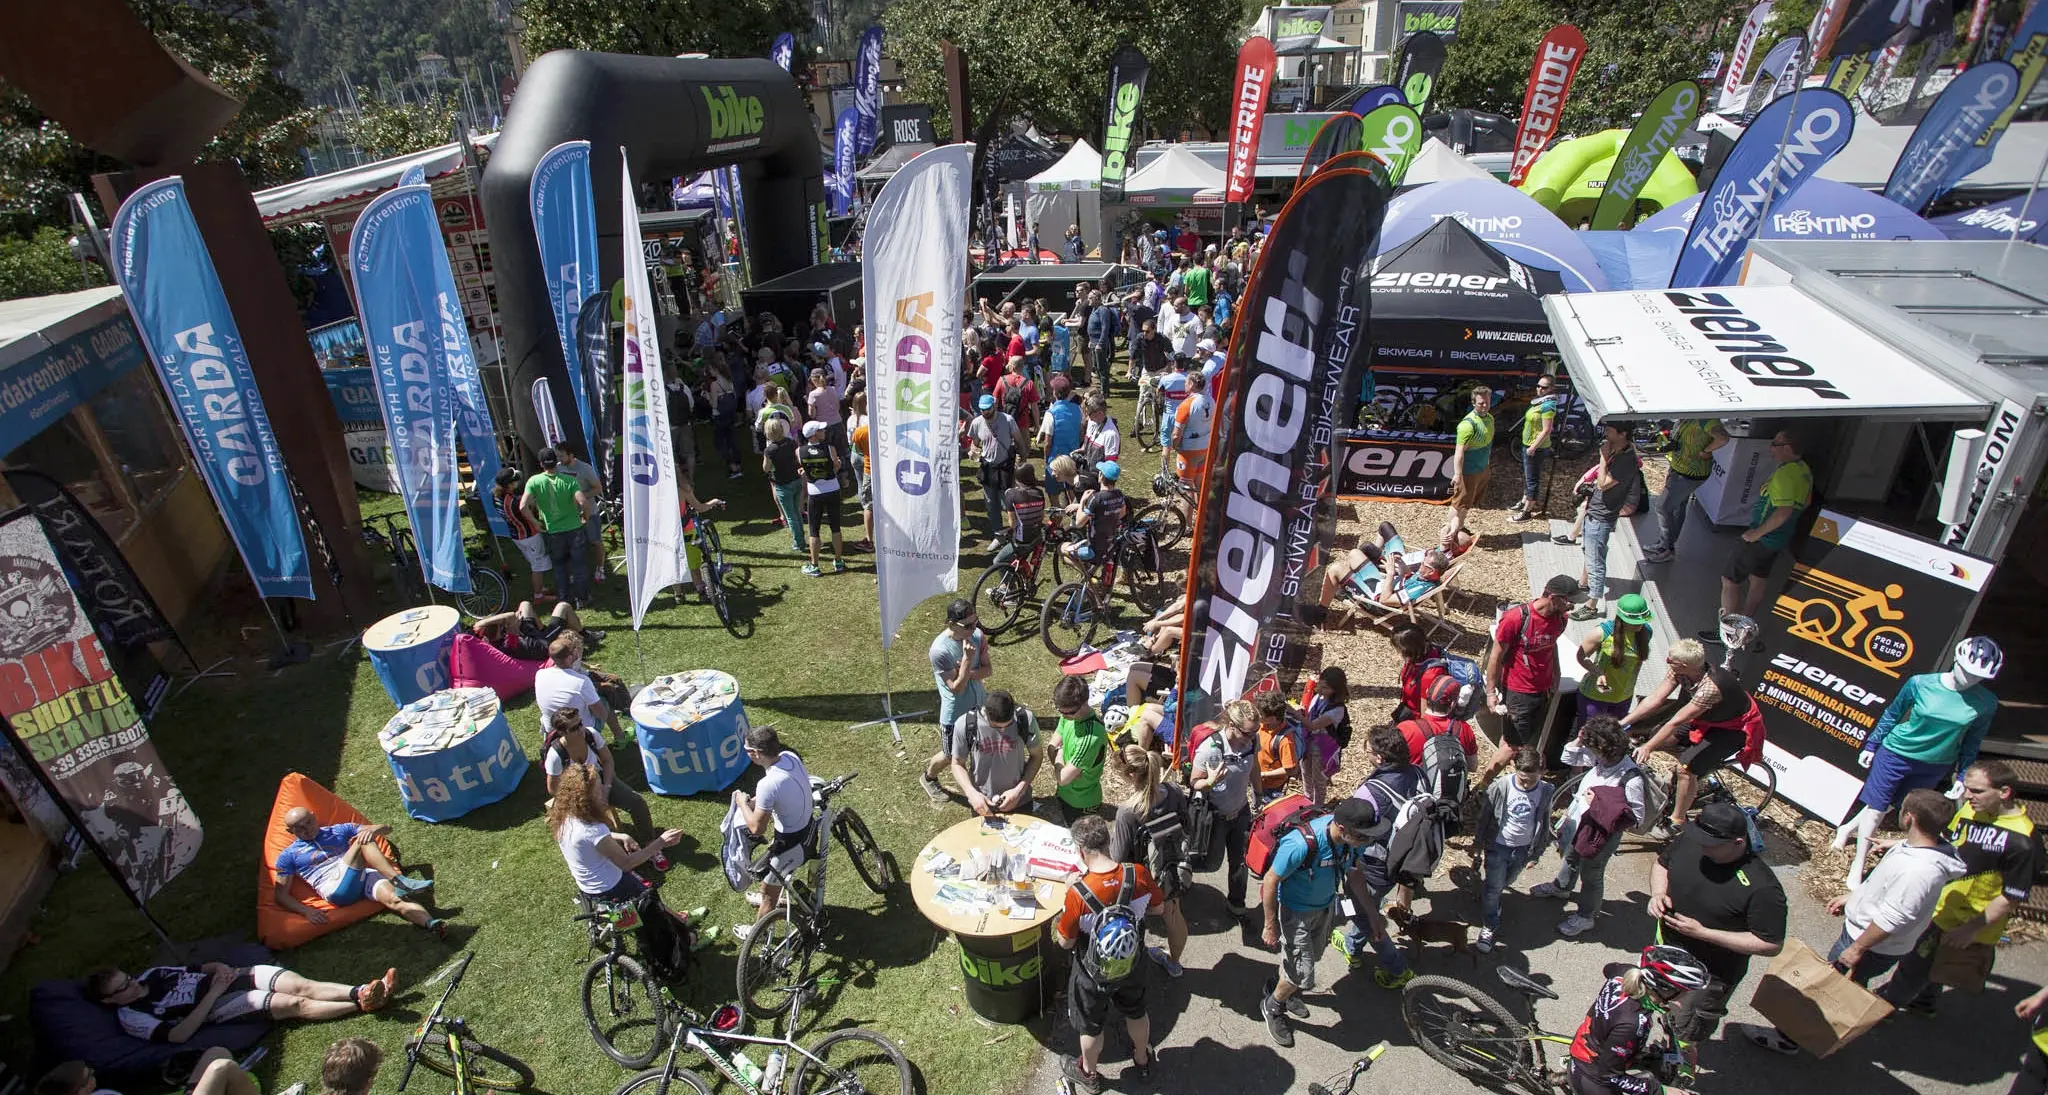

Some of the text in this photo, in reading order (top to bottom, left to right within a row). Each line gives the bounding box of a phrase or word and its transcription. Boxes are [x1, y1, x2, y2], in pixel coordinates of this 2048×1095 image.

[1277, 17, 1323, 36] bike
[1404, 12, 1457, 31] bike
[1727, 18, 1757, 95] GHOST
[701, 85, 764, 139] bike
[893, 119, 922, 143] ROSE
[1102, 82, 1140, 180] bike
[1230, 65, 1265, 194] FREERIDE
[1609, 88, 1695, 201] TRENTINO
[1698, 107, 1841, 264] TRENTINO
[1773, 213, 1876, 235] TRENTINO
[121, 189, 176, 277] #GardaTrentino
[357, 195, 421, 272] #GardaTrentino
[1369, 271, 1510, 291] ziener
[1378, 347, 1515, 363] SKIWEAR BIKEWEAR
[1476, 329, 1556, 344] WWW.ZIENER.COM
[1663, 292, 1851, 400] ziener
[161, 353, 217, 463] NORTH LAKE
[174, 322, 266, 487] GARDA
[224, 334, 283, 475] TRENTINO ITALY
[376, 344, 411, 449] NORTH LAKE
[392, 320, 439, 477] GARDA
[431, 333, 456, 469] TRENTINO ITALY
[640, 312, 672, 480] TRENTINO ITALY
[875, 323, 890, 460] NORTH LAKE
[896, 291, 935, 497] GARDA
[937, 307, 957, 488] TRENTINO ITALY
[1282, 484, 1320, 598] SKIWEAR
[1314, 305, 1360, 446] BIKEWEAR
[1356, 481, 1424, 494] SKIWEAR
[1712, 460, 1726, 477] ner
[0, 633, 115, 716] BIKE
[1871, 642, 1902, 658] 3 EURO
[1875, 635, 1892, 646] PRO
[1757, 682, 1867, 741] 3 MINUTEN VOLLGAS
[1763, 670, 1876, 729] SPENDENMARATHON
[1770, 653, 1886, 706] ziener
[1753, 691, 1862, 749] LASST DIE ROLLEN RAUCHEN
[49, 752, 77, 774] +39
[959, 943, 1045, 988] bike
